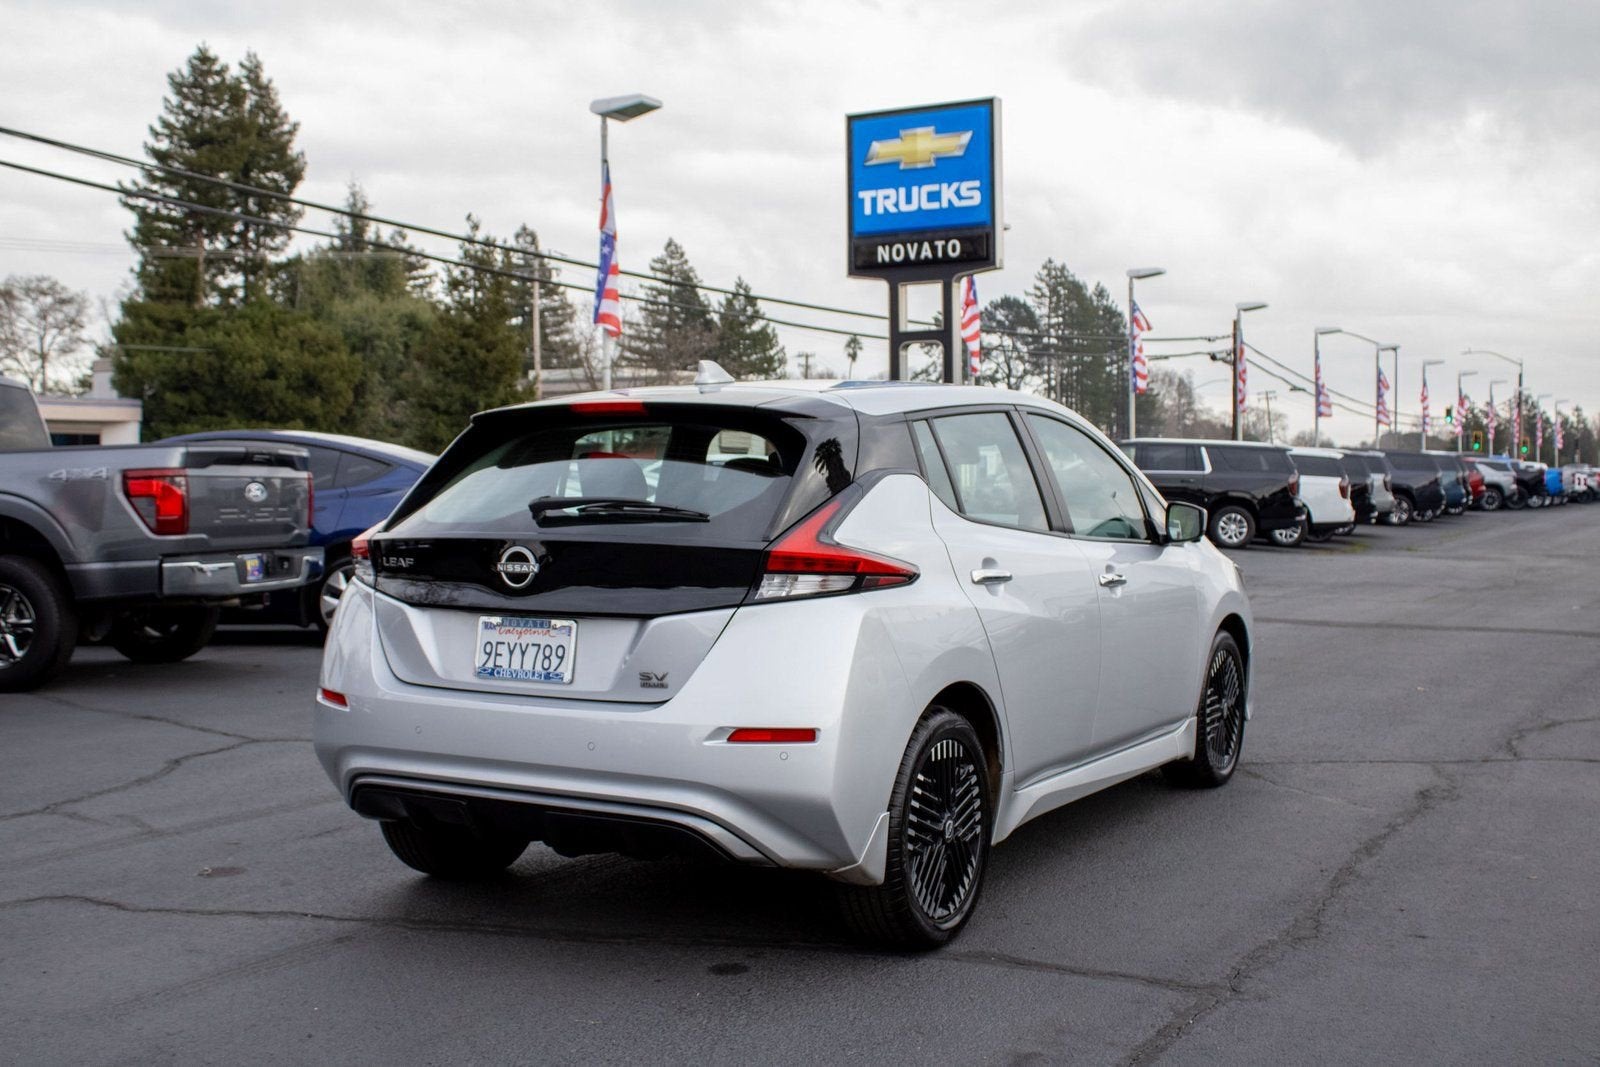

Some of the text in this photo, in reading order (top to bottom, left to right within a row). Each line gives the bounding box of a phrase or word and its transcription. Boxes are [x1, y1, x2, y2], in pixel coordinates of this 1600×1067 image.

[858, 180, 982, 216] TRUCKS
[877, 238, 961, 263] NOVATO
[383, 556, 415, 568] LEAF
[497, 561, 539, 574] NISSAN
[503, 617, 550, 629] NOVATO
[497, 626, 557, 640] California
[482, 641, 566, 672] 9EYY789
[494, 667, 546, 680] CHEVROLET
[639, 671, 669, 682] SV
